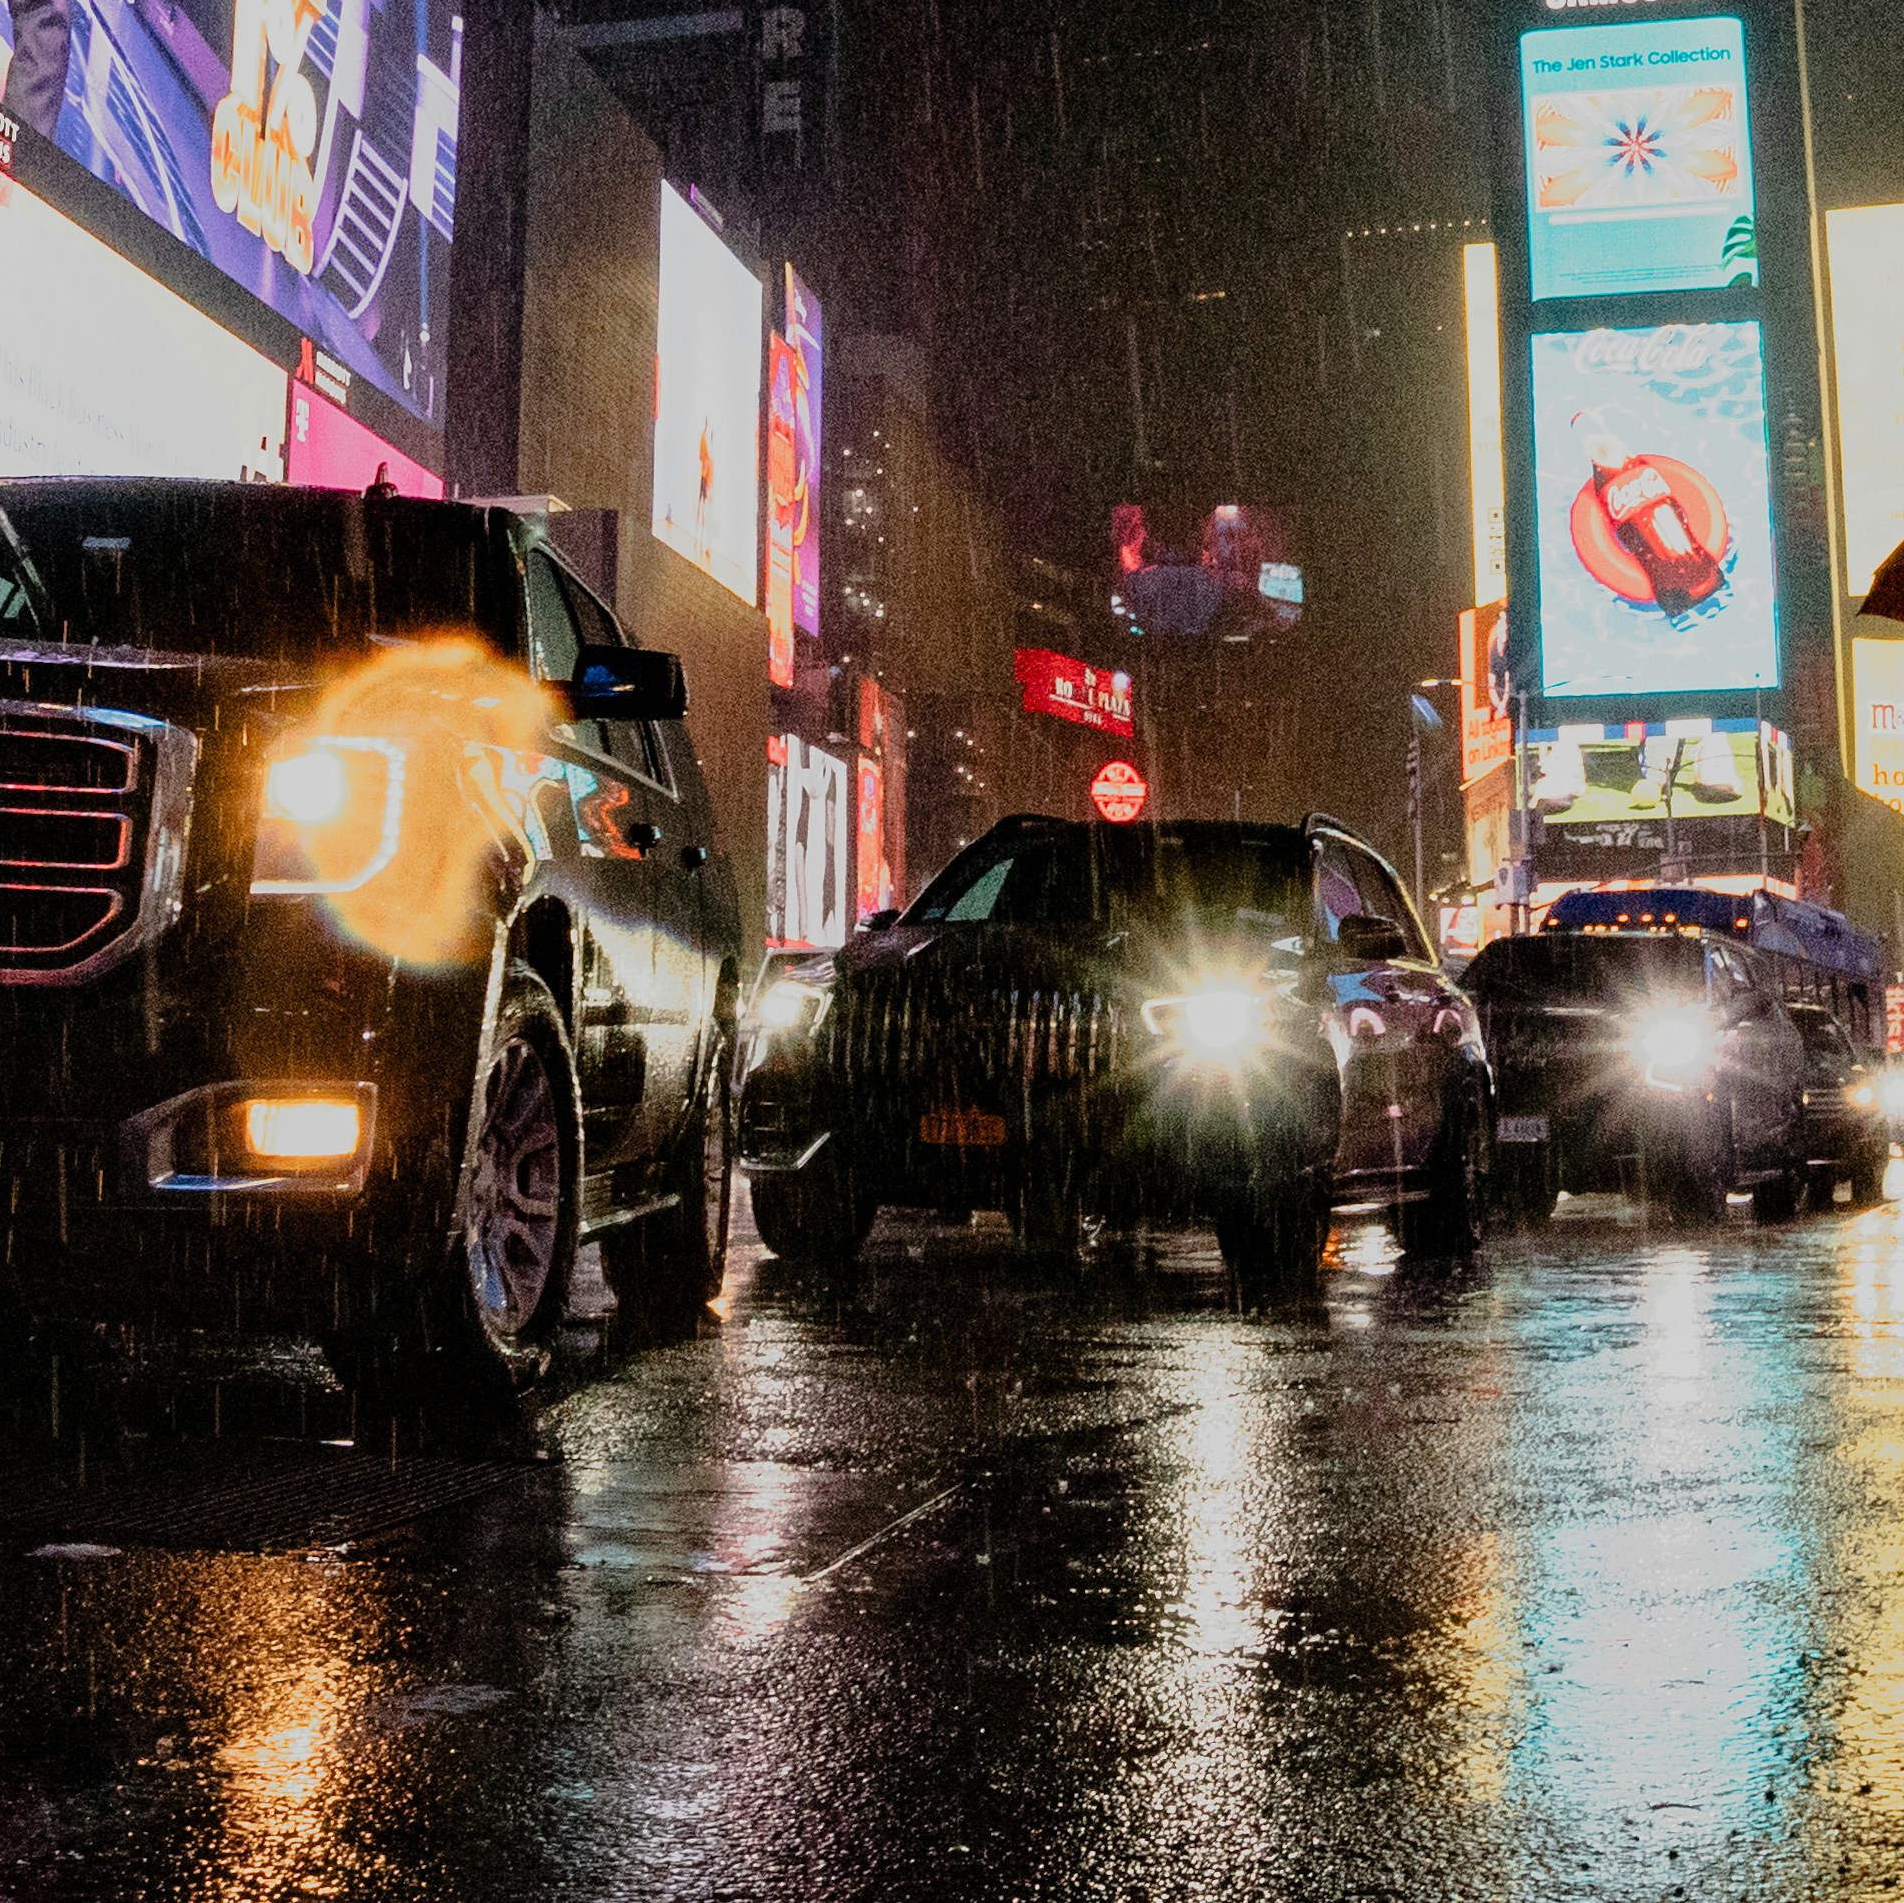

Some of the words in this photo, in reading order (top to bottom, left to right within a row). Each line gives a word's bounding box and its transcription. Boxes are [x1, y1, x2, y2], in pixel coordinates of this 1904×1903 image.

[1533, 59, 1563, 74] The
[1567, 57, 1596, 72] Jen
[1600, 52, 1644, 69] Stark
[1648, 46, 1731, 66] Collection
[211, 94, 315, 275] CLUB
